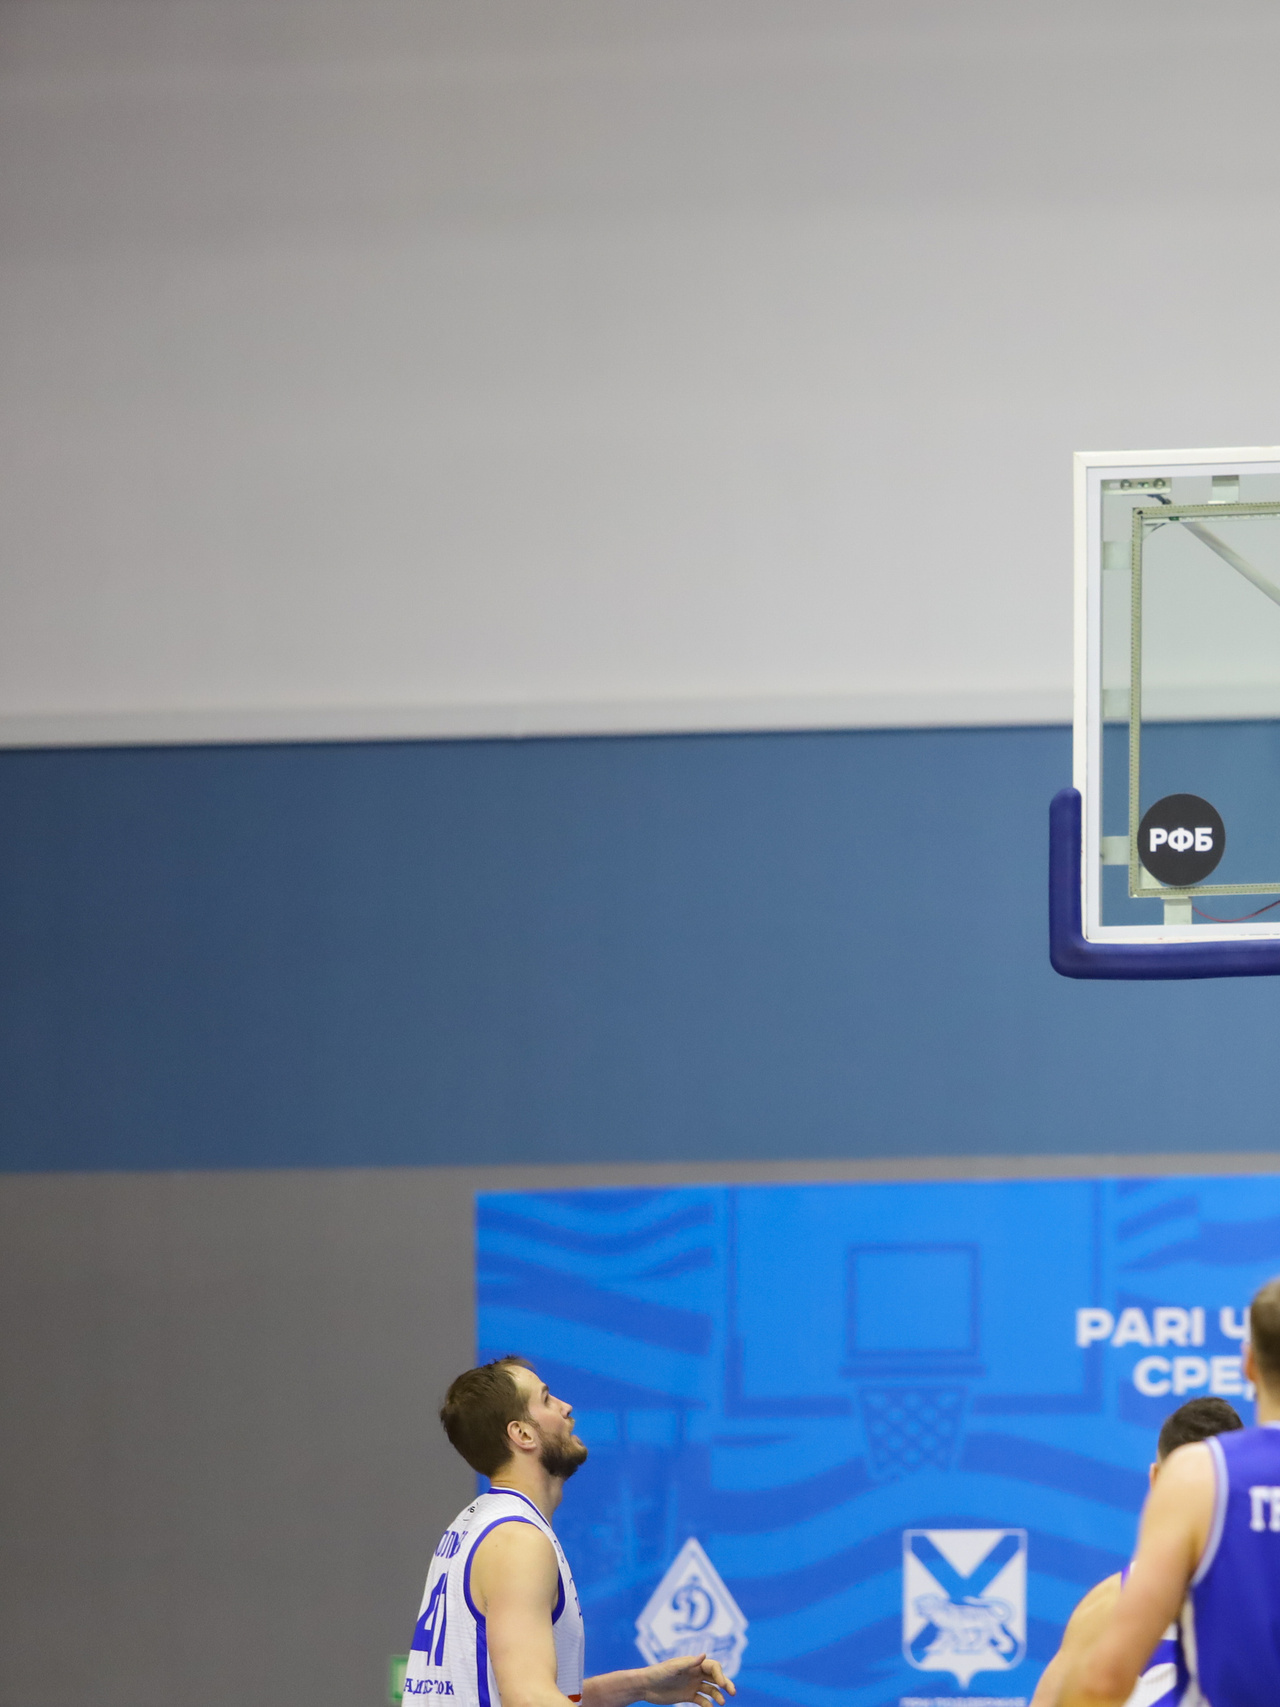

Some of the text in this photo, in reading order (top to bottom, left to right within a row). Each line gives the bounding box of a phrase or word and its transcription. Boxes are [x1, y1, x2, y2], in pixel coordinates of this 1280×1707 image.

[1149, 827, 1214, 852] РФБ
[1076, 1306, 1206, 1346] PARI
[1133, 1355, 1256, 1398] СРЕ
